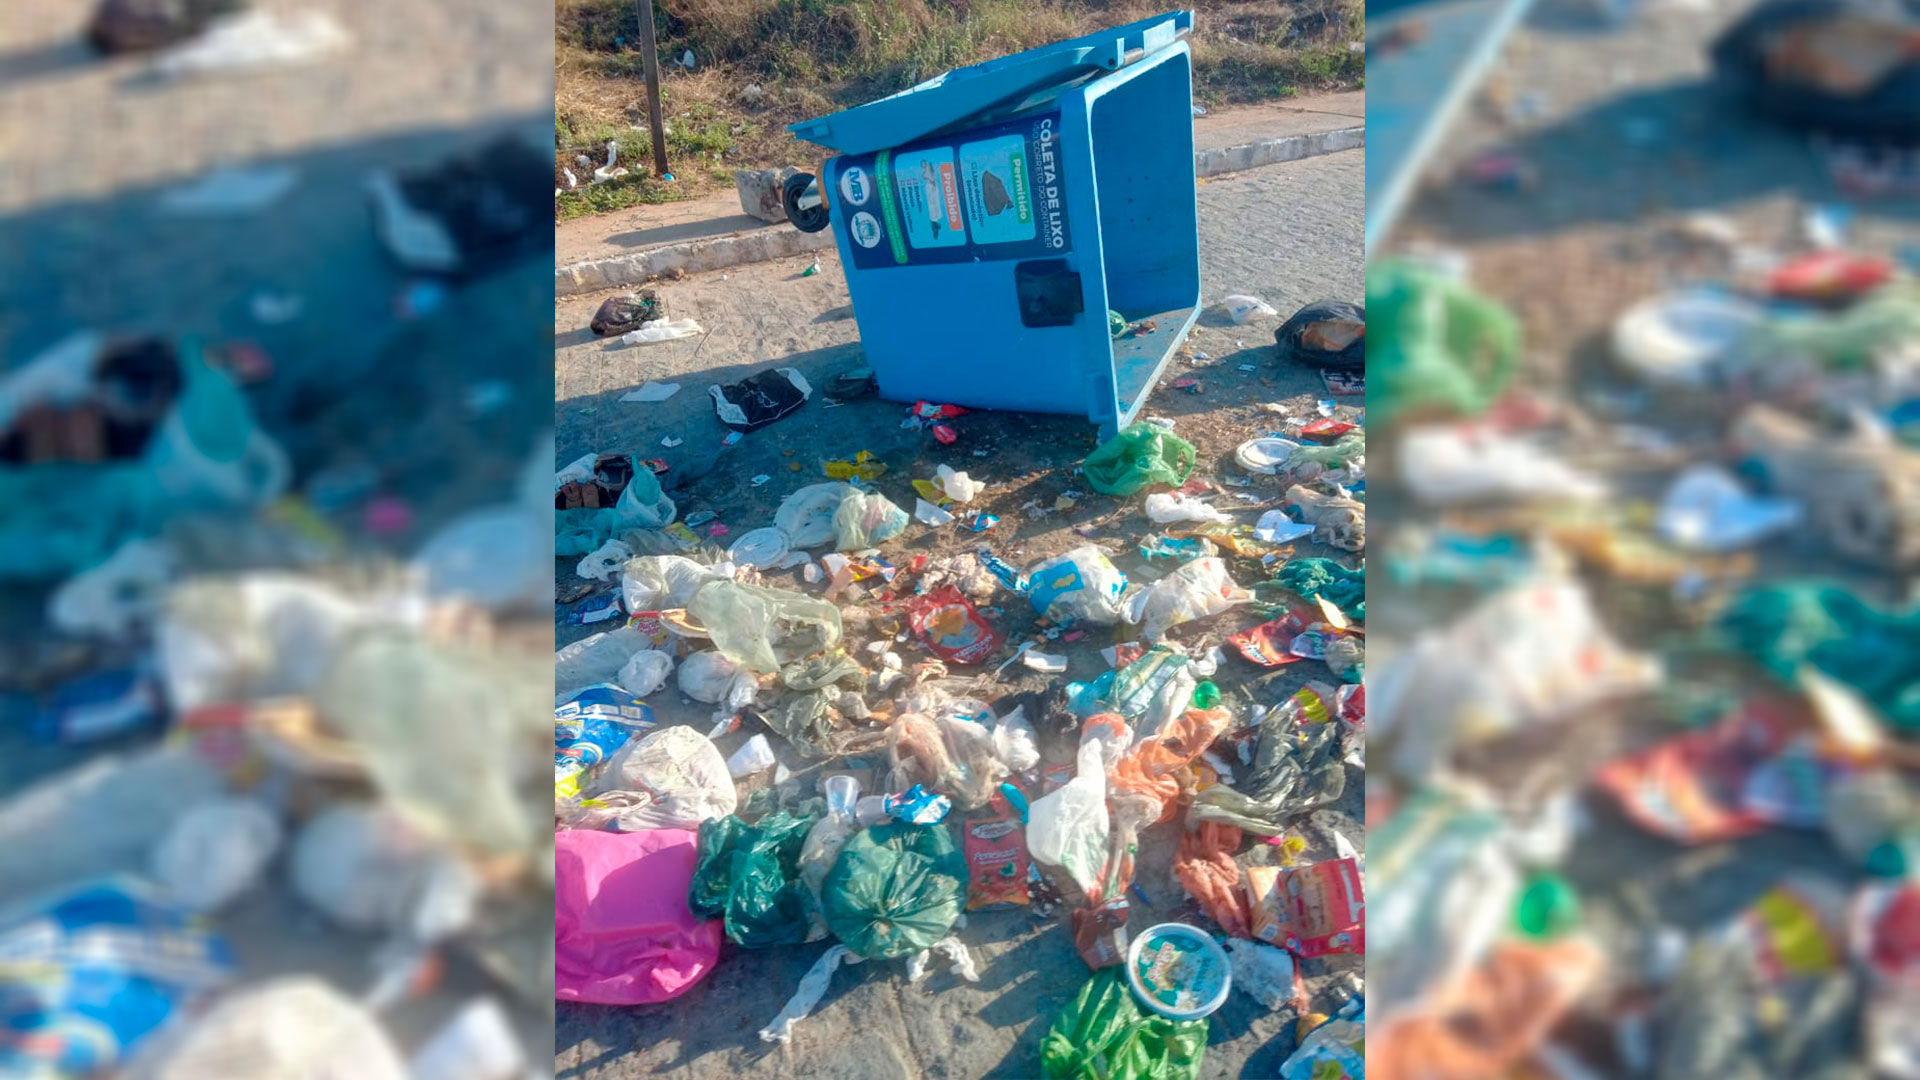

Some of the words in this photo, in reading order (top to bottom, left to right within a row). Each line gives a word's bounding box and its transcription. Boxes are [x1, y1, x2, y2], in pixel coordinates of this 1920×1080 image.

[1032, 120, 1041, 139] USO
[1040, 118, 1056, 184] COLETA
[1032, 140, 1044, 183] CORRETO
[943, 172, 958, 223] Proibido
[1012, 158, 1028, 220] Permitido
[1038, 186, 1046, 200] DO
[1046, 187, 1059, 210] DE
[1039, 201, 1052, 248] CONTAINER
[1049, 212, 1064, 249] LIXO
